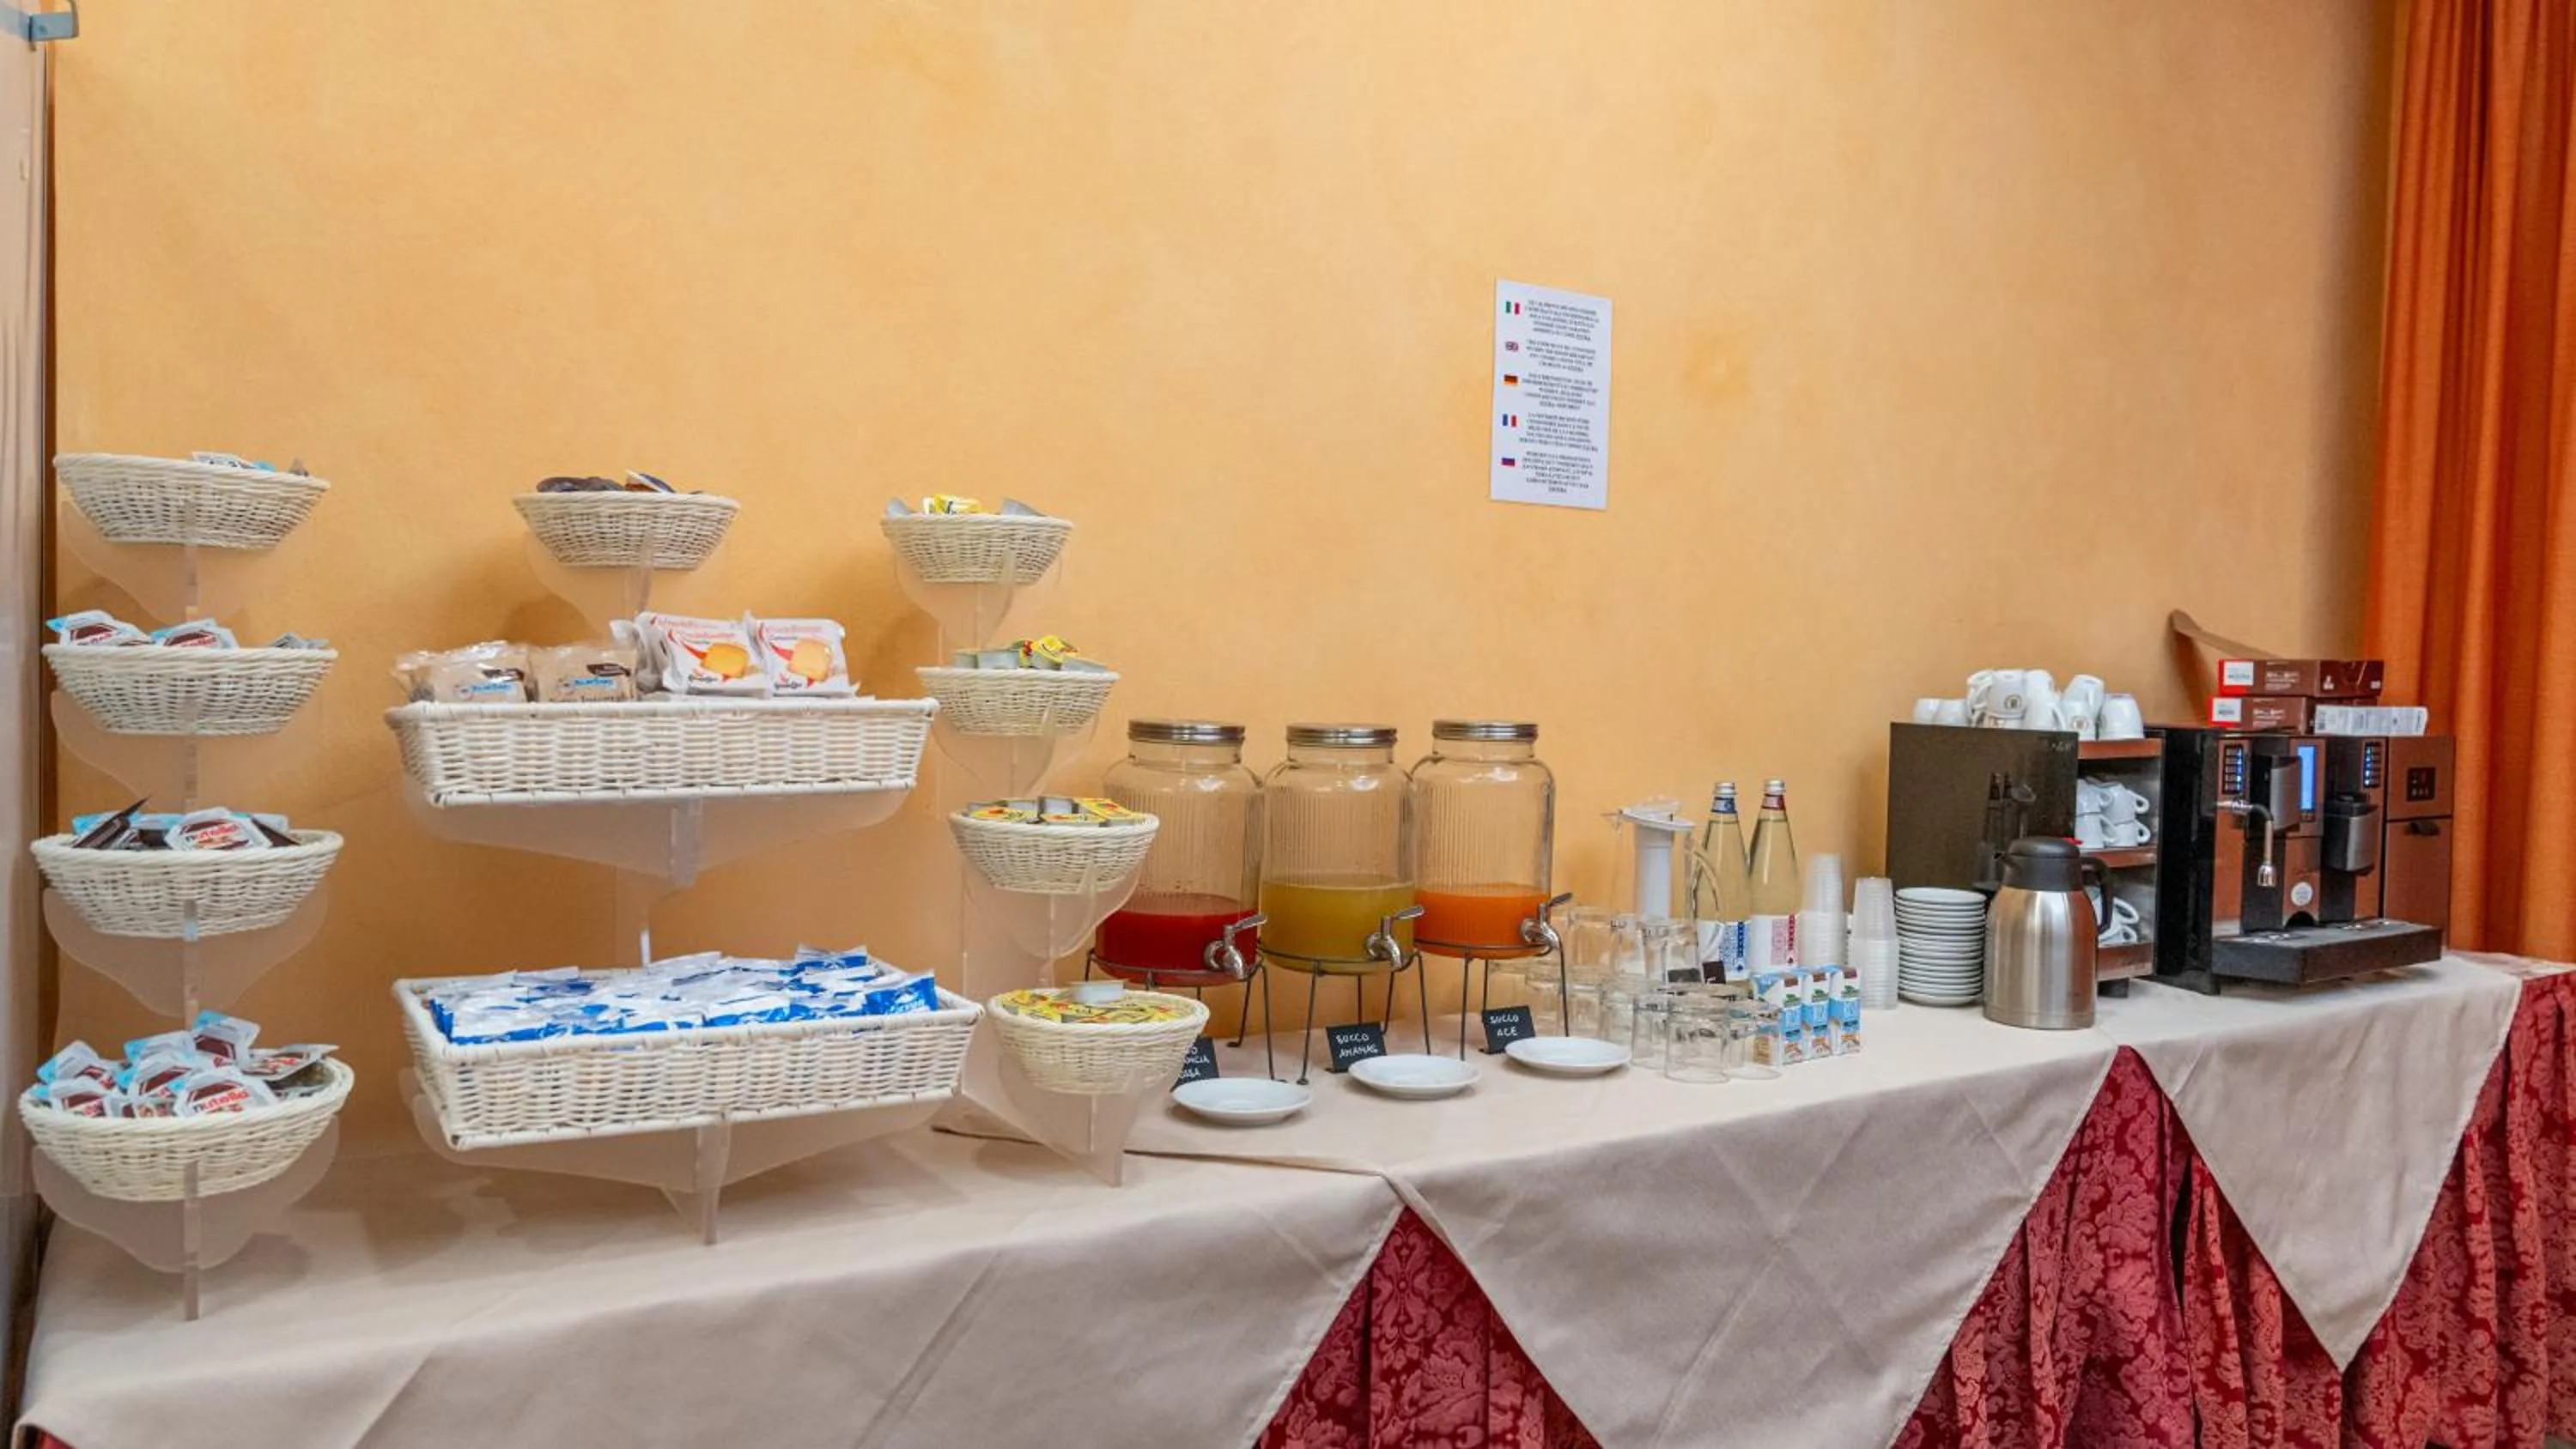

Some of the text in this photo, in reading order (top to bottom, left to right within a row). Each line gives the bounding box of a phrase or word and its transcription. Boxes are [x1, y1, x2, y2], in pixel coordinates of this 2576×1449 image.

[1497, 1027, 1518, 1037] ACE
[1336, 1033, 1370, 1044] SUCCO
[191, 1088, 248, 1113] nutella
